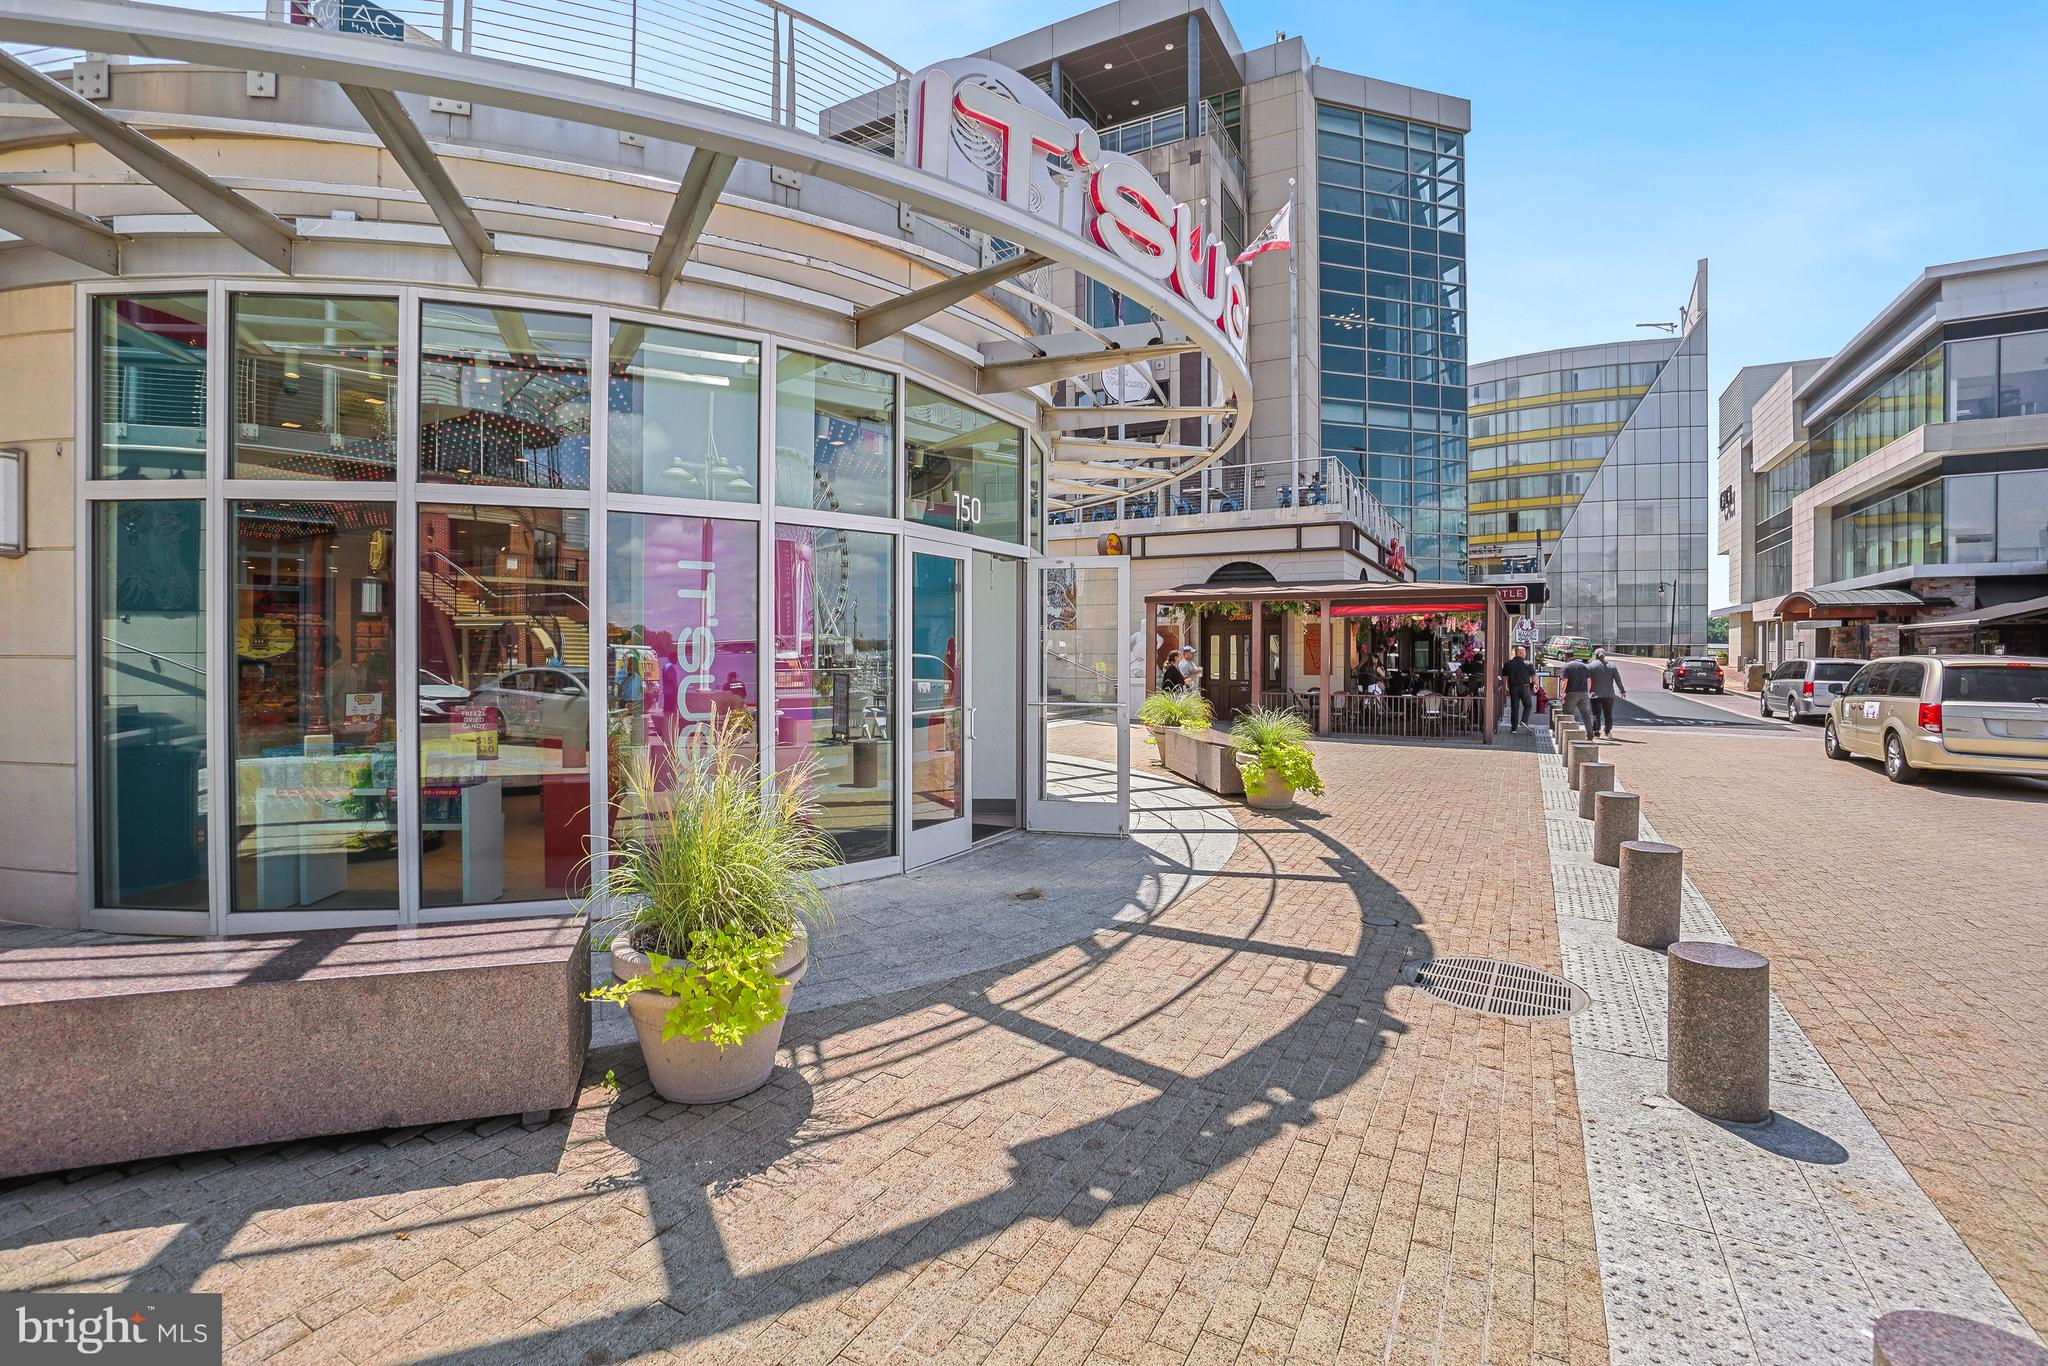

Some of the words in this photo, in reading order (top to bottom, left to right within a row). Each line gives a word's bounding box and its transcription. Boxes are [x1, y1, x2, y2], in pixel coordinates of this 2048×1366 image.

[352, 4, 397, 39] AC
[953, 491, 981, 524] 150
[677, 560, 719, 772] IT'SUG
